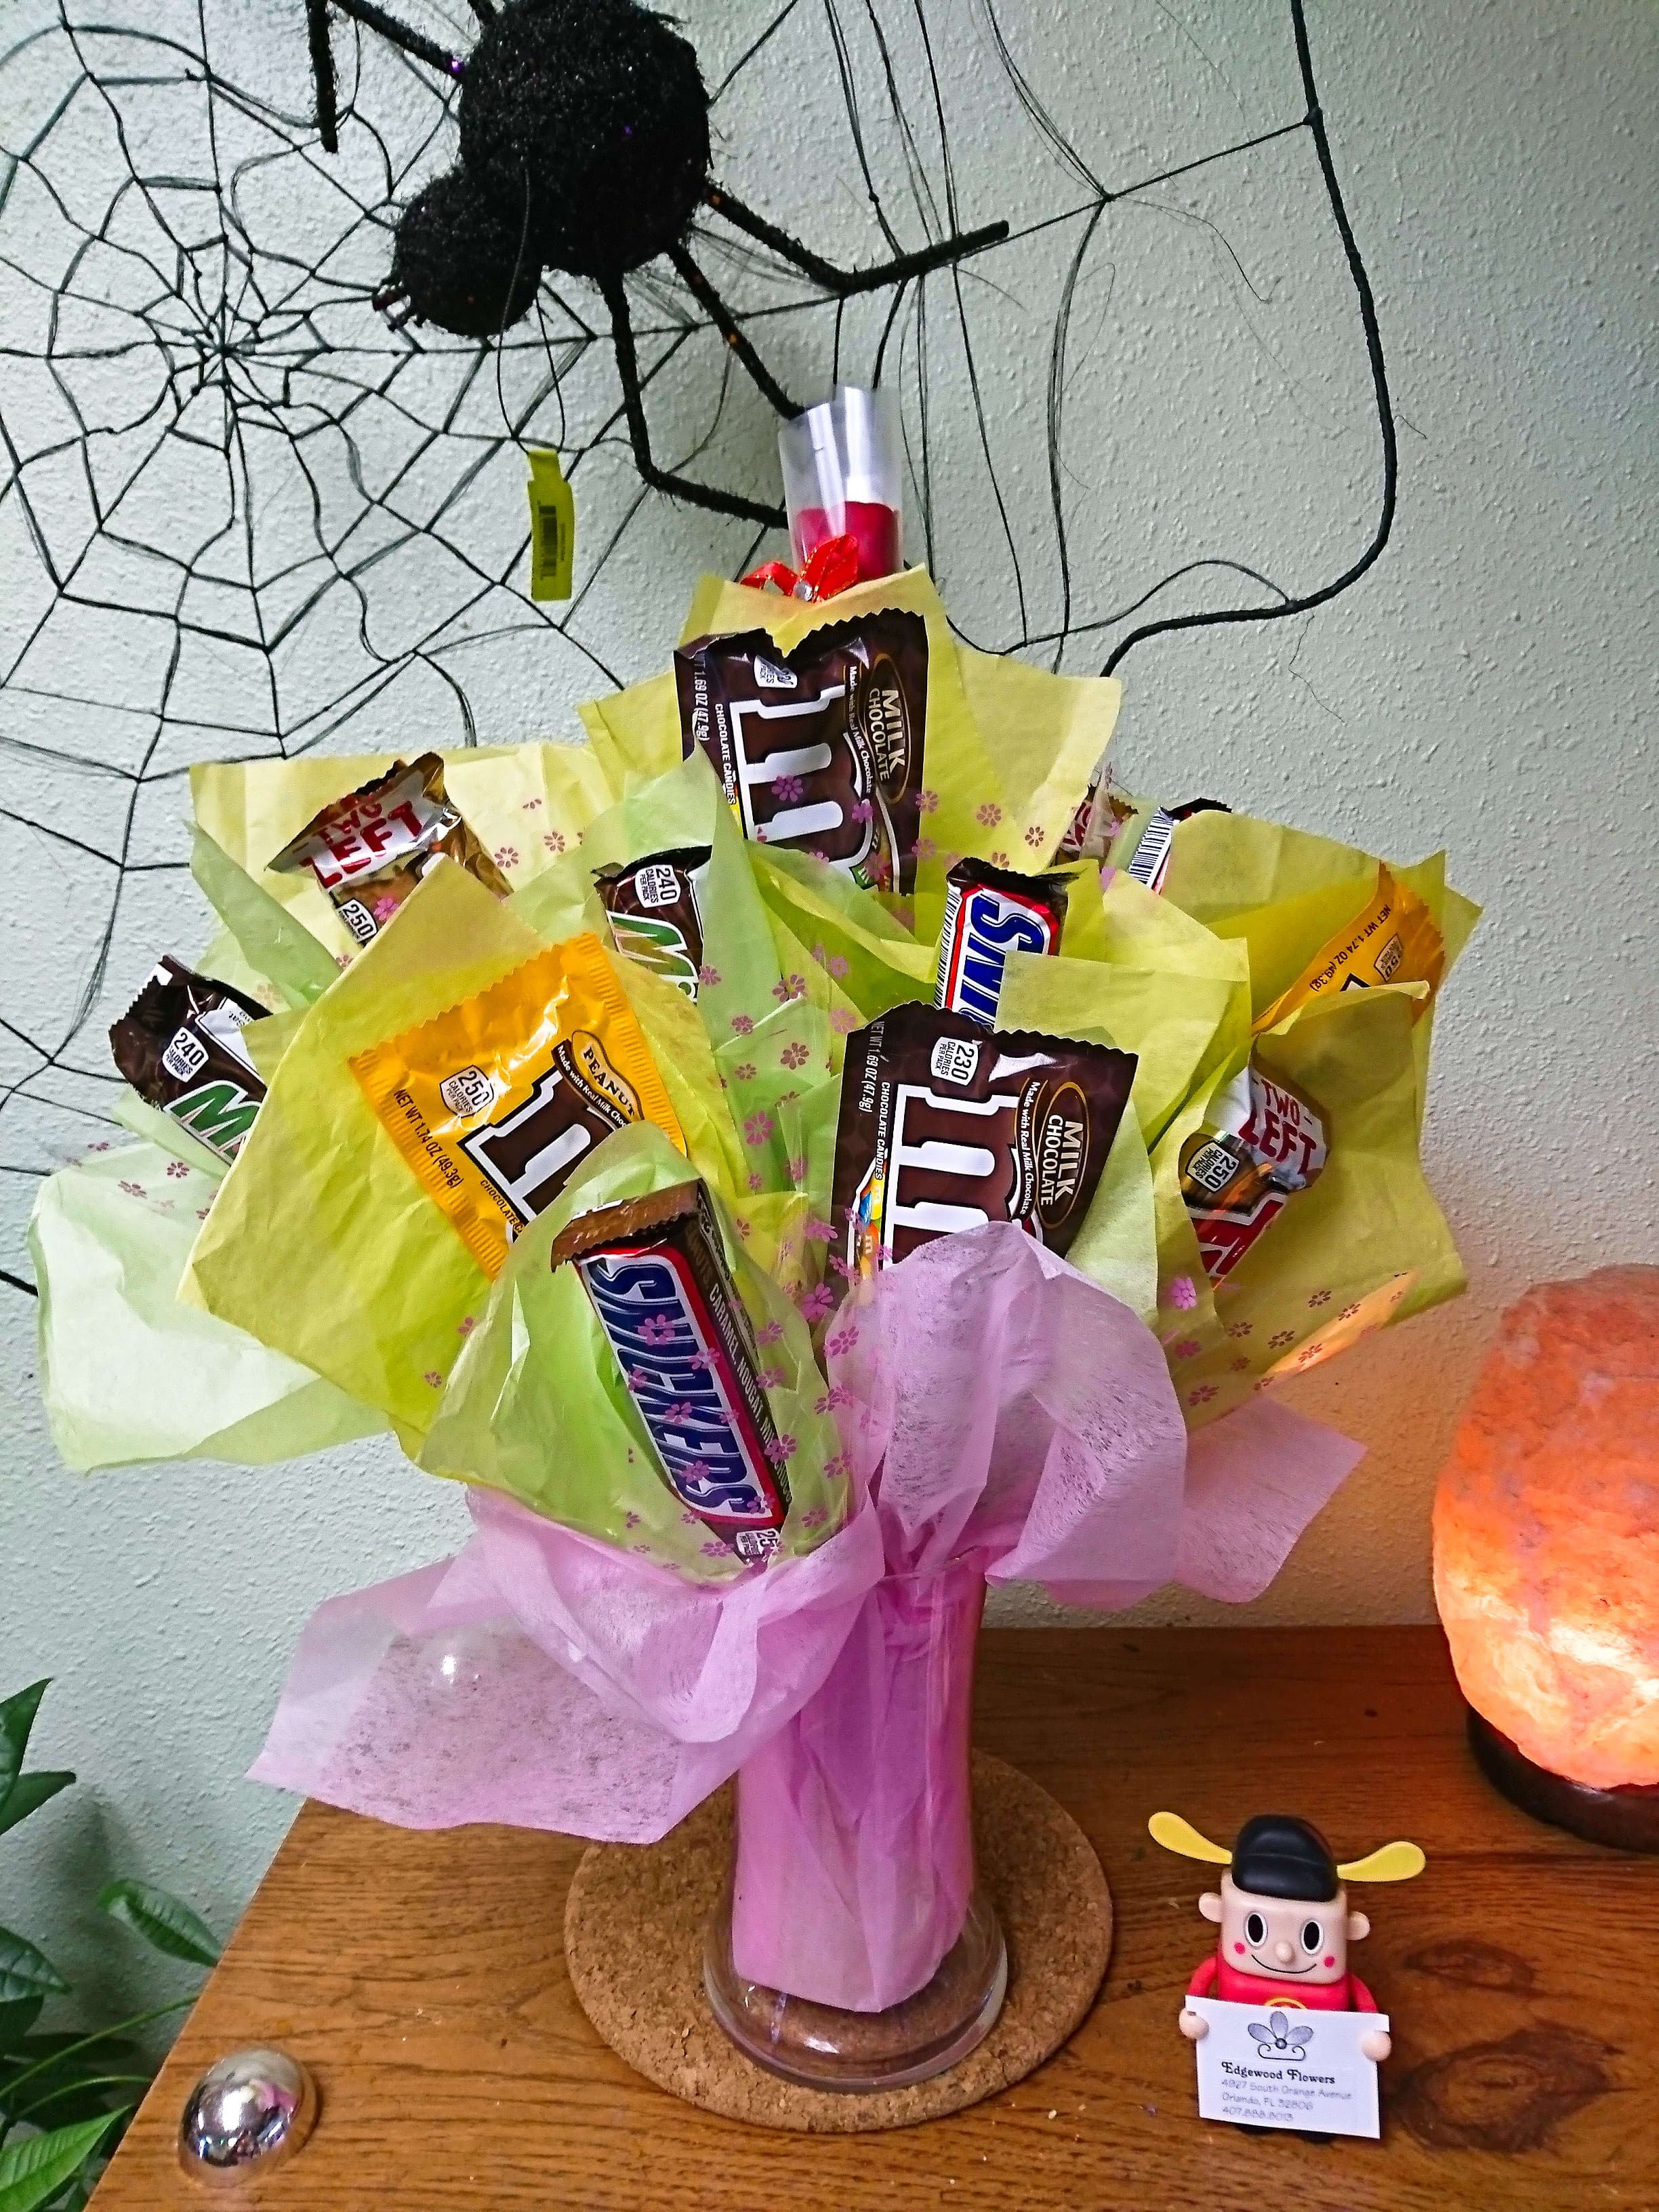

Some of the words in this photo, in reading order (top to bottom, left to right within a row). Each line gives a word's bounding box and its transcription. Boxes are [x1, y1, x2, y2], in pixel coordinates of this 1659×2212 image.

[694, 670, 707, 691] 1.69
[695, 692, 708, 707] OZ
[694, 707, 710, 741] (47.9g)
[849, 665, 857, 692] Made
[853, 731, 864, 750] Milk
[861, 750, 873, 794] Chocolate
[869, 688, 889, 781] CHOCOLATE
[882, 689, 905, 774] MILK
[715, 703, 731, 762] CHOCOLATE
[723, 763, 736, 804] CANDIES
[314, 802, 384, 845] TWO
[300, 800, 423, 889] LEFT
[646, 869, 659, 903] CALORIES
[656, 868, 677, 900] 240
[343, 904, 373, 935] 250
[1363, 921, 1379, 937] WT
[1377, 904, 1391, 924] NET
[1334, 951, 1349, 965] OZ
[1346, 935, 1365, 954] 1.74
[1309, 961, 1337, 992] (49.3g)
[174, 1032, 204, 1065] 240
[866, 1048, 880, 1067] 1.69
[869, 1037, 882, 1048] WT
[938, 1043, 947, 1056] PER
[865, 1067, 878, 1080] OZ
[935, 1056, 945, 1070] PACK
[941, 1042, 956, 1076] CALORIES
[951, 1044, 975, 1082] 230
[457, 1070, 490, 1106] 250
[558, 1044, 571, 1071] Made
[569, 1069, 584, 1088] with
[582, 1085, 598, 1102] Real
[596, 1098, 611, 1113] Milk
[583, 1046, 635, 1116] PEANUT
[1023, 1082, 1041, 1107] Made
[394, 1088, 409, 1108] NET
[449, 1080, 474, 1112] CALORIES
[858, 1080, 876, 1113] (47.9g)
[878, 1082, 890, 1137] CHOCOLATE
[1261, 1078, 1300, 1126] TWO
[405, 1105, 424, 1124] WT
[1021, 1107, 1030, 1129] with
[414, 1122, 434, 1144] 1.74
[1021, 1130, 1029, 1151] Real
[1238, 1107, 1317, 1175] LEFT
[425, 1141, 443, 1158] OZ
[875, 1139, 886, 1180] CANDIES
[1022, 1151, 1033, 1172] Milk
[1041, 1115, 1063, 1206] CHOCOLATE
[1054, 1120, 1084, 1202] MILK
[1195, 1149, 1223, 1179] CALORIES
[1202, 1147, 1214, 1160] PER
[432, 1153, 464, 1188] (49.3g)
[1205, 1155, 1237, 1189] 250
[480, 1179, 516, 1227] CHOCOLATE
[1020, 1172, 1035, 1215] Chocolate
[588, 1257, 762, 1515] SNICKERS
[1221, 2062, 1283, 2080] Edgewood
[1287, 2068, 1336, 2084] Flowers
[1250, 2082, 1279, 2093] South
[1282, 2085, 1315, 2098] Orange
[1319, 2089, 1352, 2100] Avenue
[1264, 2097, 1275, 2107] FL
